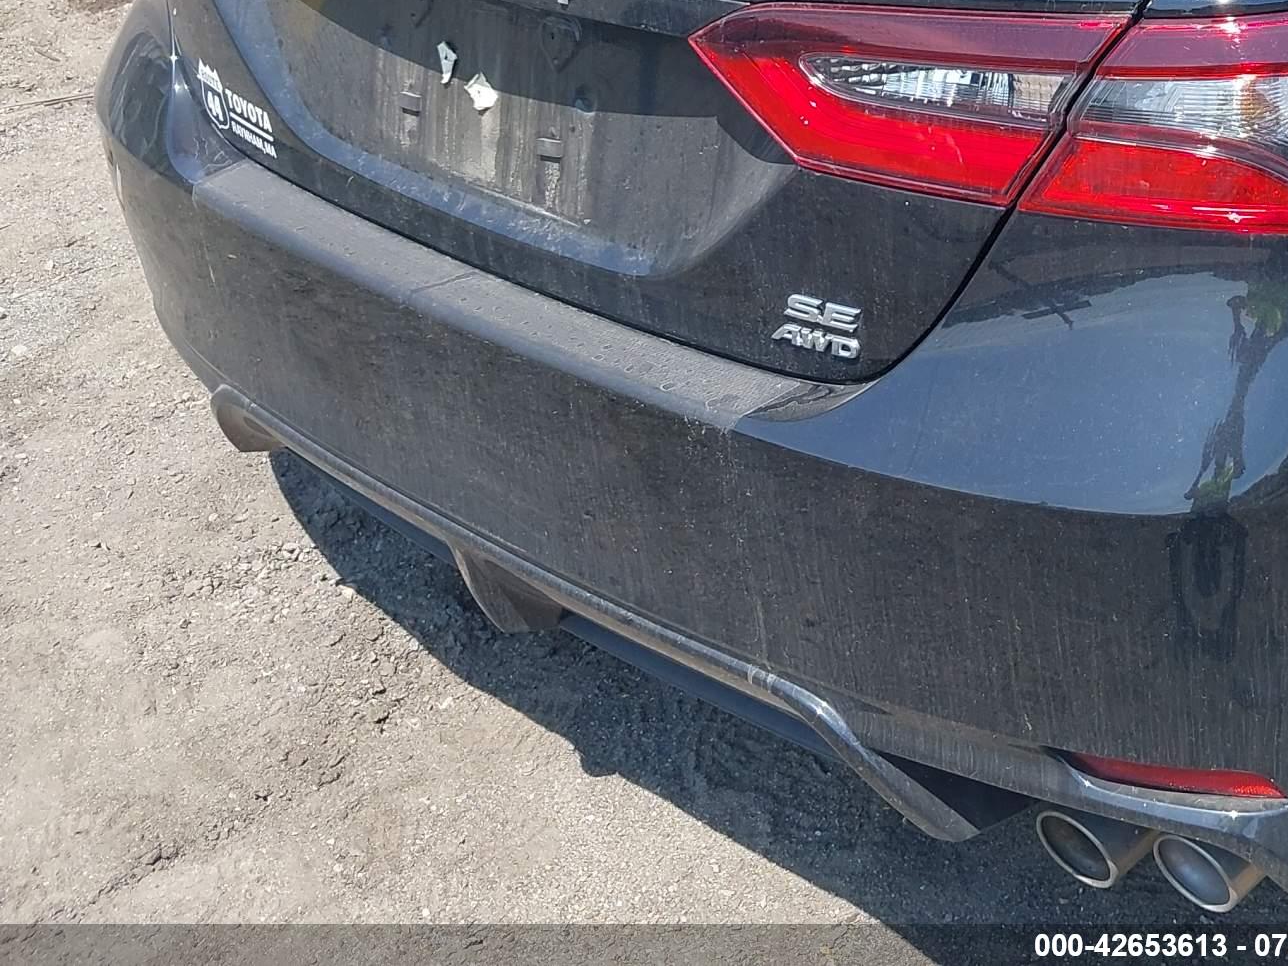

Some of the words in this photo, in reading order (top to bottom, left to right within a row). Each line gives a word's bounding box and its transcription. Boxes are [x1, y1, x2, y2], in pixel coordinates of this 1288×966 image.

[207, 91, 224, 122] 44
[225, 88, 272, 133] TOYOTA
[783, 294, 861, 333] SE
[770, 323, 860, 359] AWD
